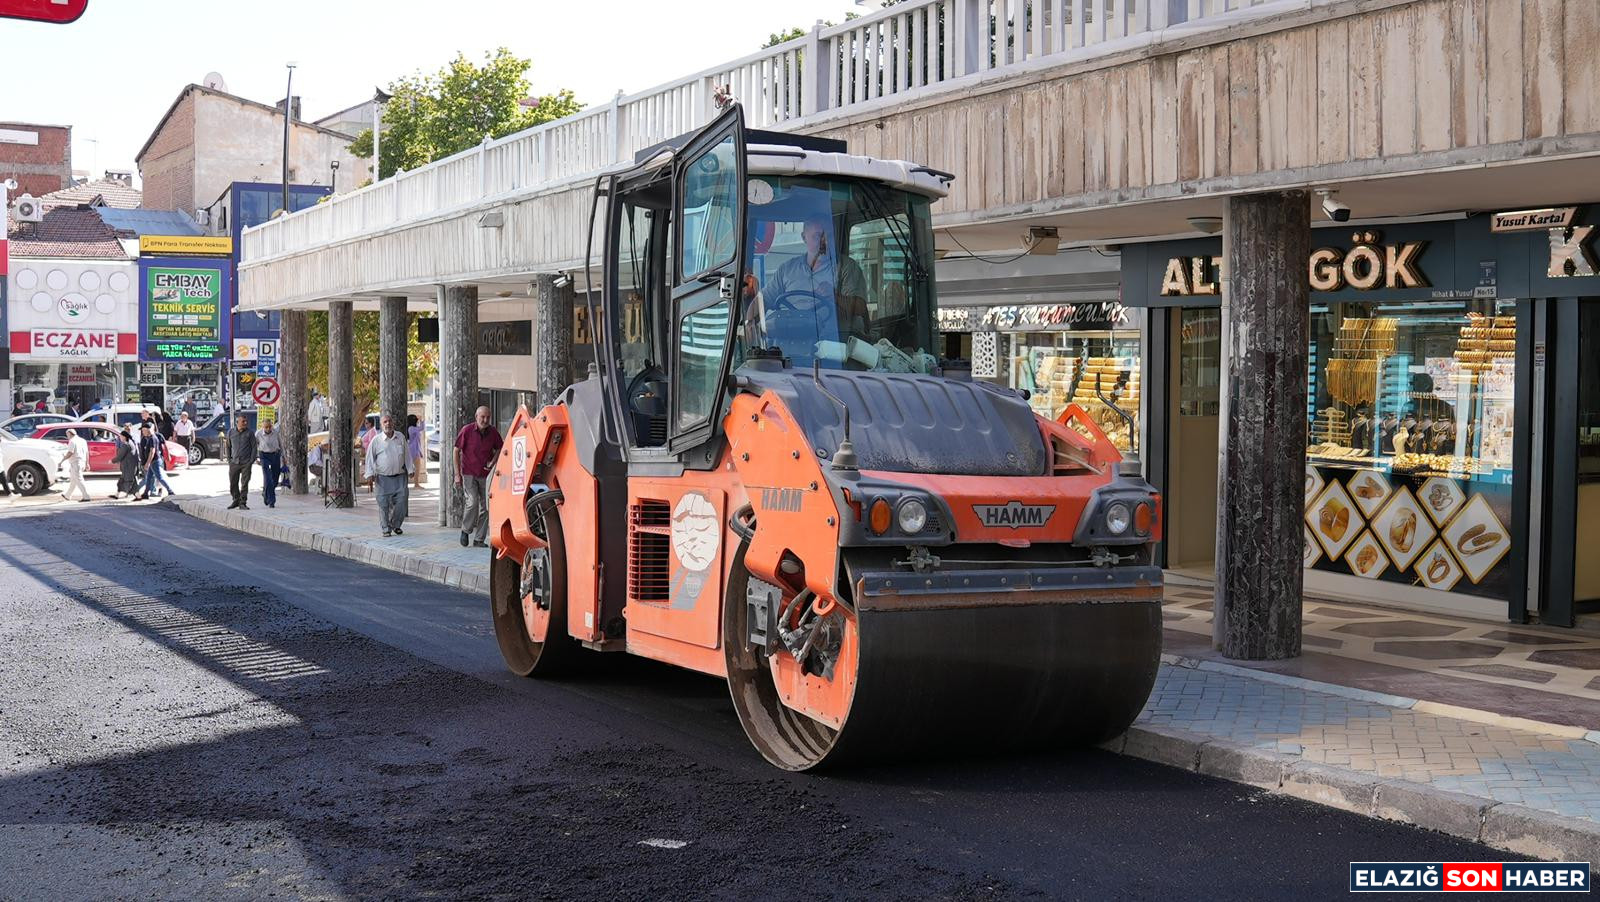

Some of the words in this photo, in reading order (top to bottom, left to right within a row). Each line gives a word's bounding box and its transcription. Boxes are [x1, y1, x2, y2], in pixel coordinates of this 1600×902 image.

[1495, 214, 1526, 228] Yusuf
[1528, 212, 1566, 226] Kartal
[184, 288, 211, 297] Tech
[1431, 289, 1449, 298] Nihat
[1455, 289, 1473, 297] Yusuf
[152, 303, 184, 313] TEKNİK
[185, 302, 216, 314] SERVİS
[33, 332, 116, 349] ECZANE
[262, 343, 272, 355] D
[71, 366, 92, 374] SAĞLIK
[760, 488, 803, 513] HAMM
[985, 506, 1044, 526] HAMM
